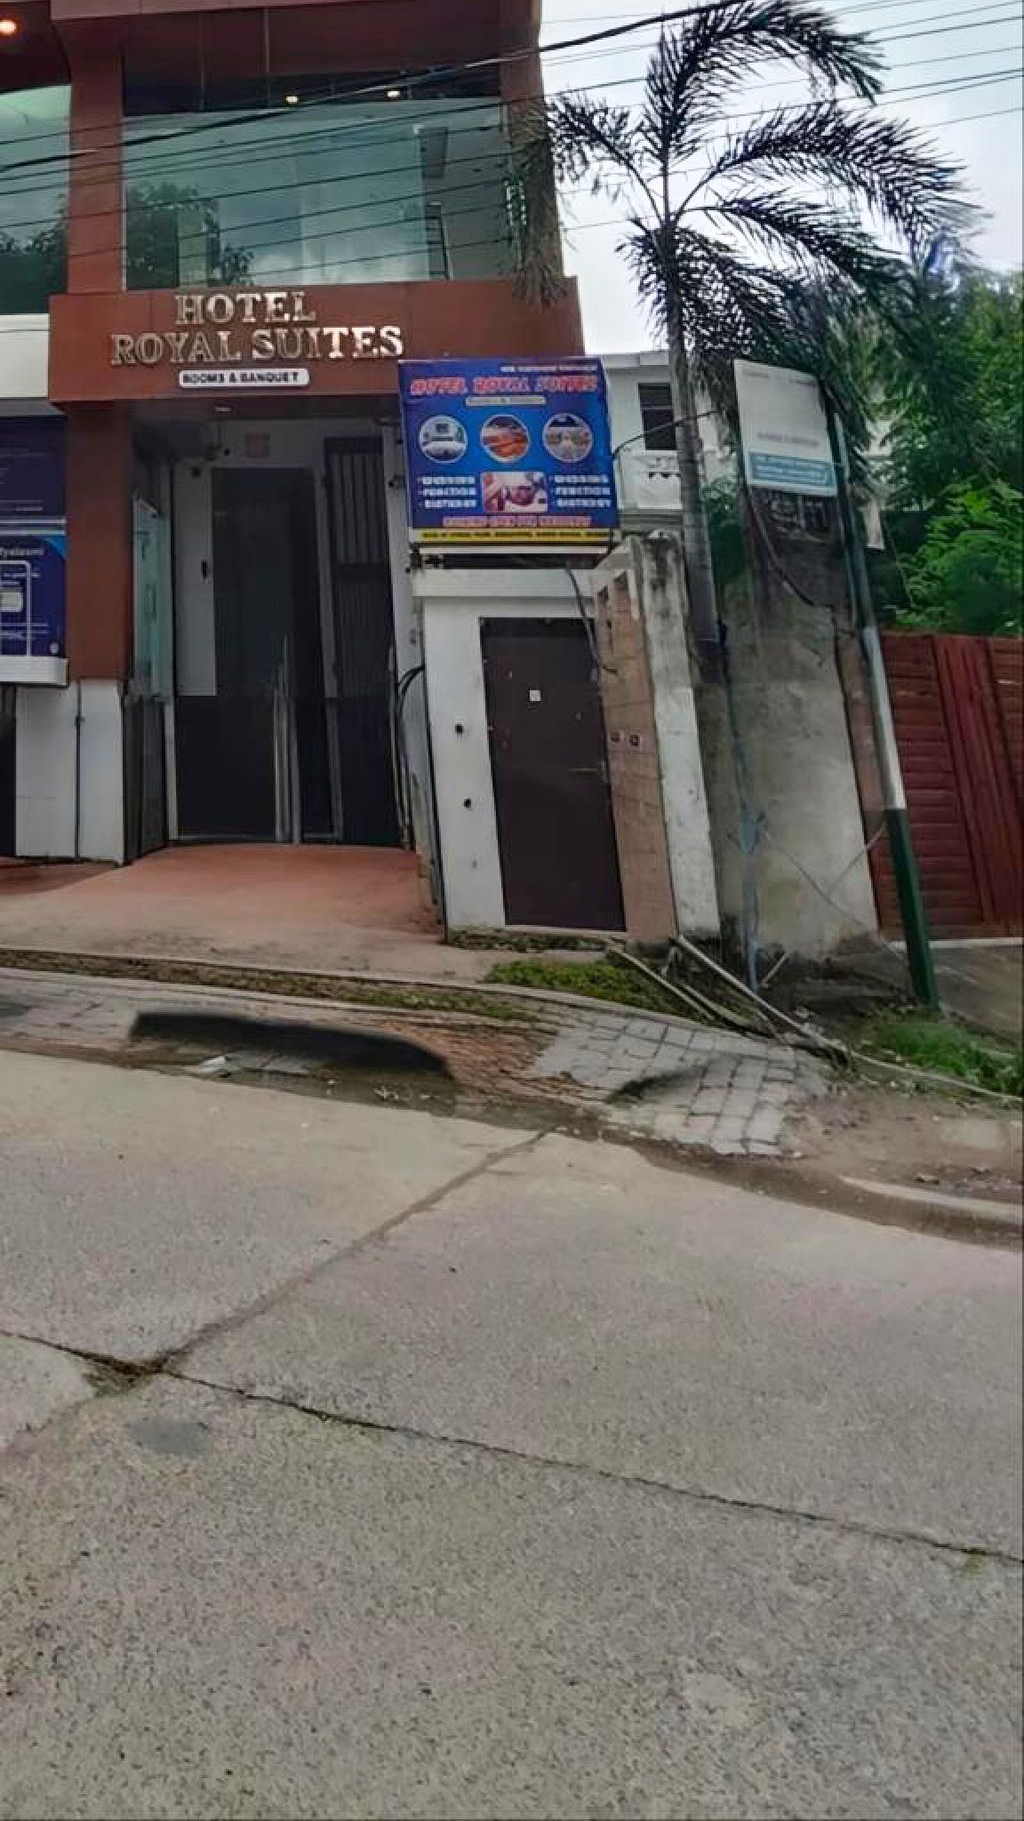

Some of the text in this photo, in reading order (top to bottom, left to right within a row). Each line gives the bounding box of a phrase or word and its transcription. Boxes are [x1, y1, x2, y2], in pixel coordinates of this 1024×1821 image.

[175, 291, 317, 325] HOTEL
[111, 326, 404, 365] ROYAL SUITES
[182, 373, 225, 385] ROOMS
[239, 371, 300, 384] BANQUET
